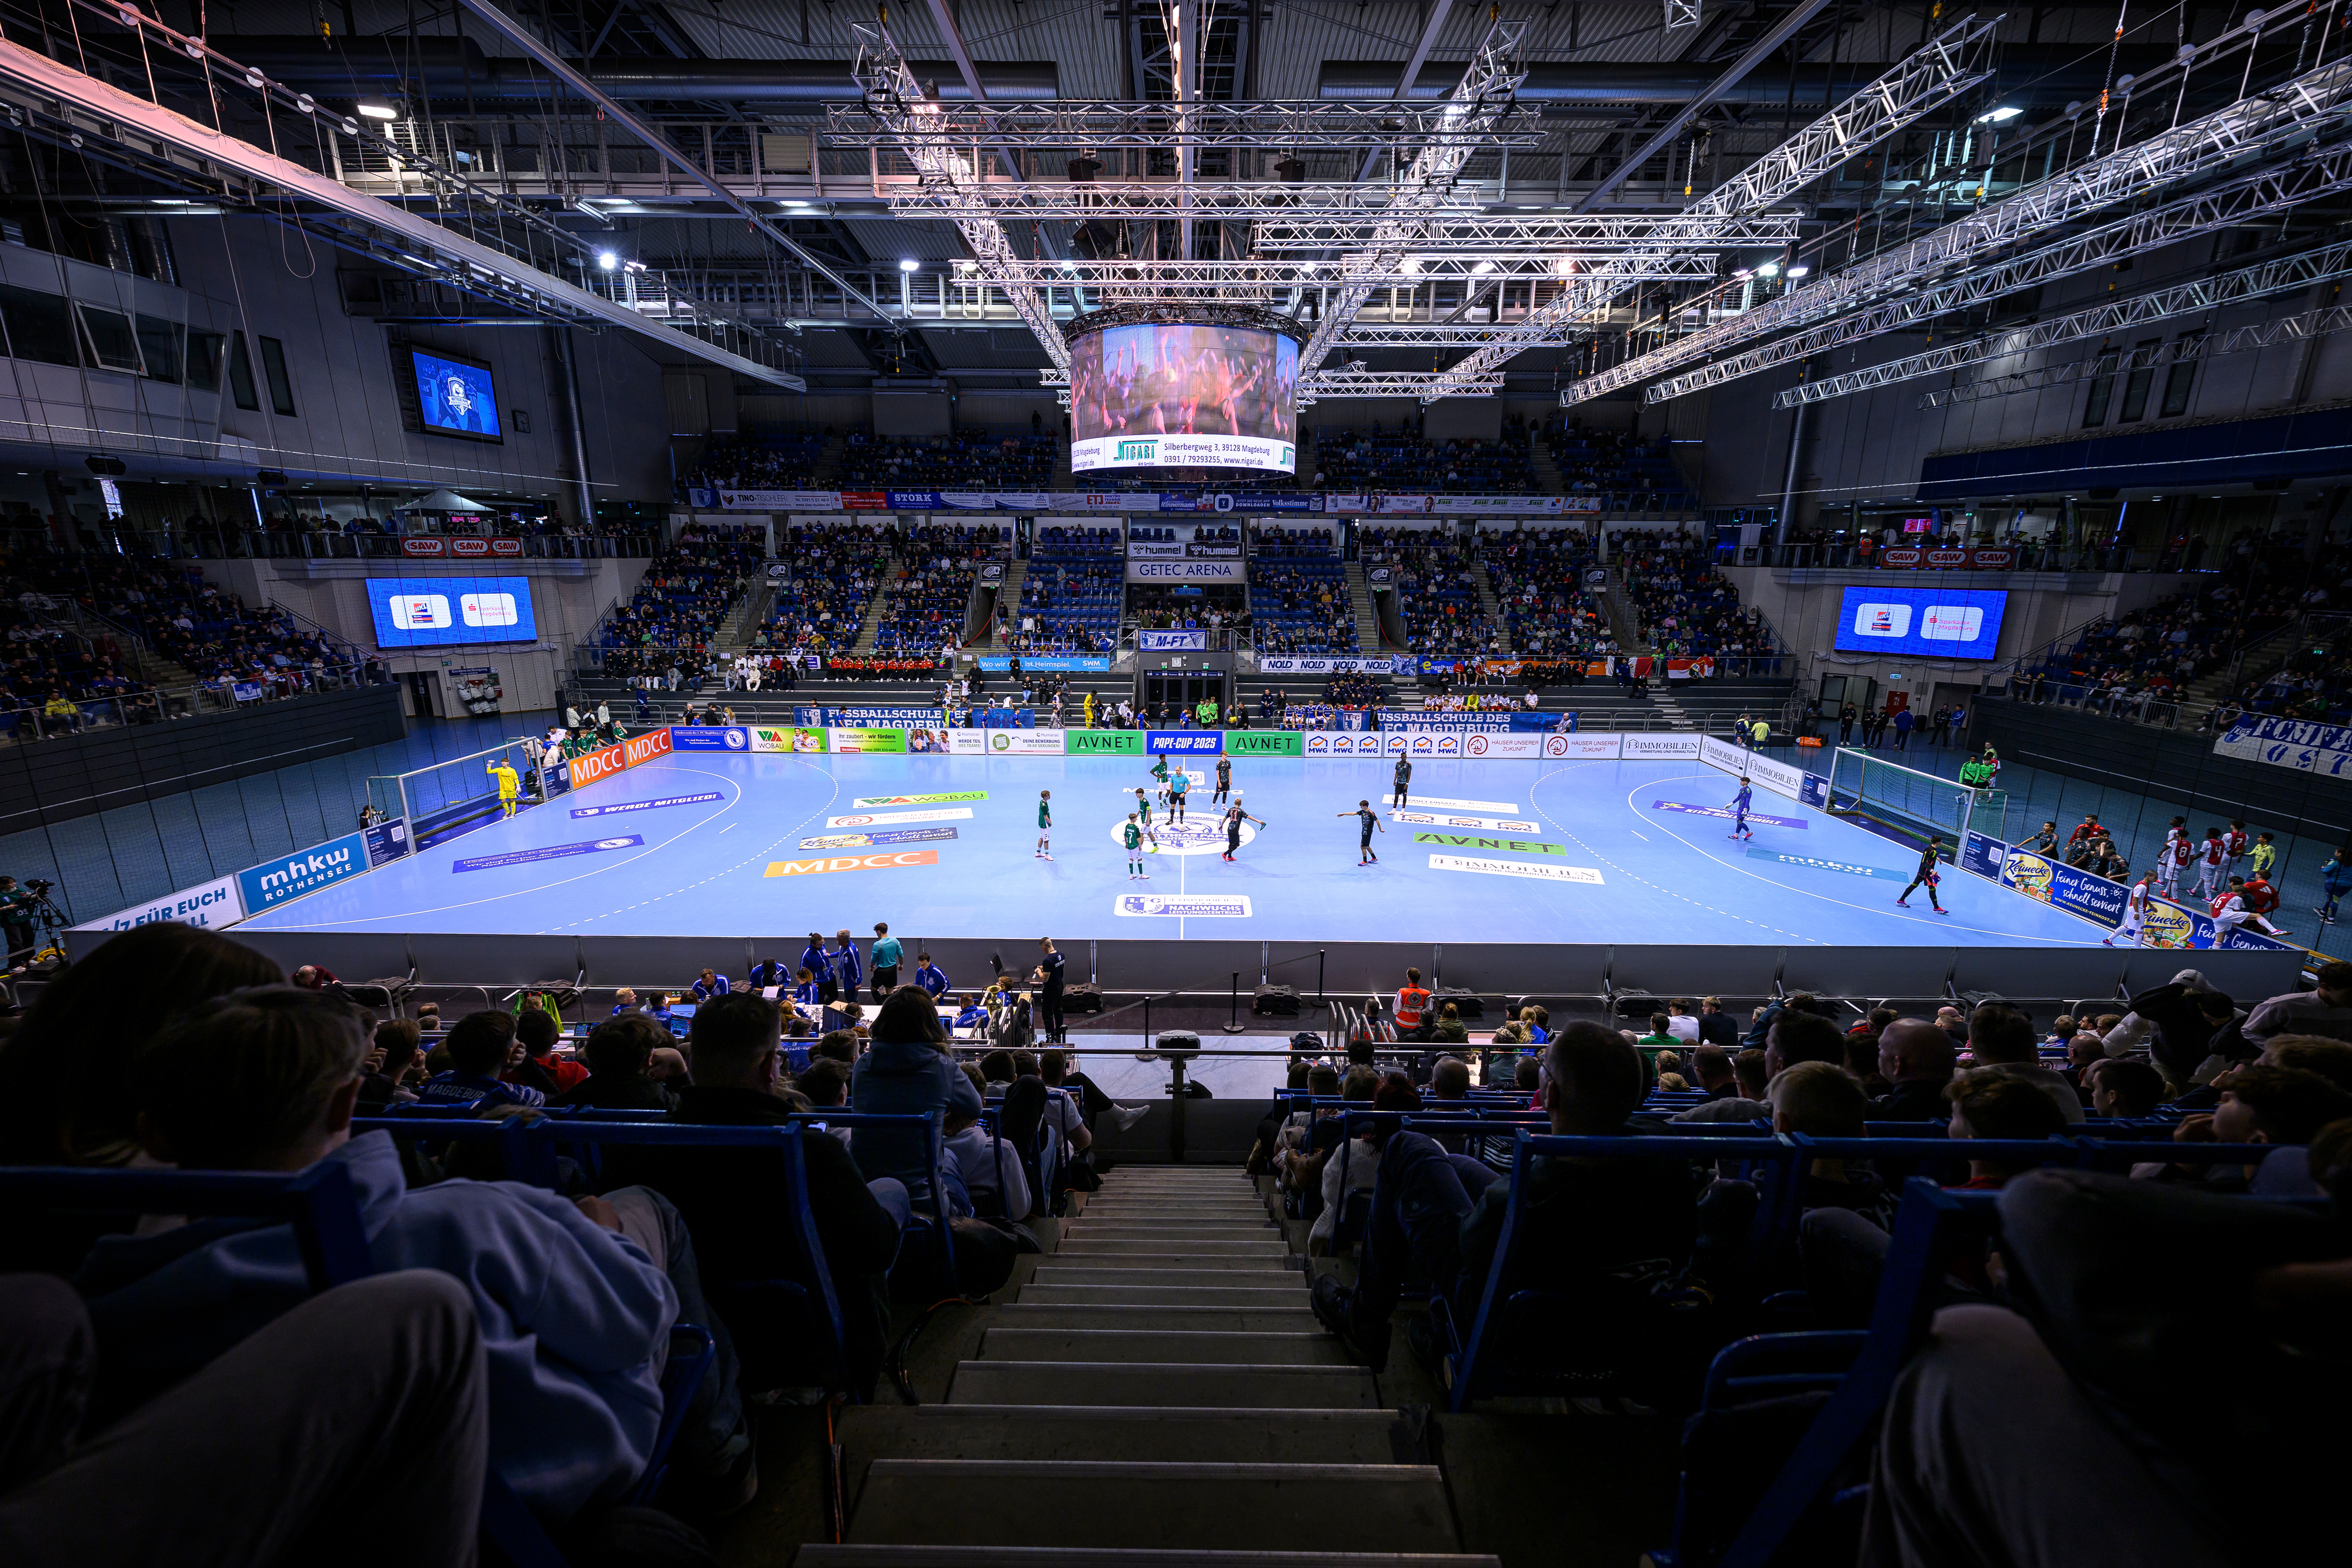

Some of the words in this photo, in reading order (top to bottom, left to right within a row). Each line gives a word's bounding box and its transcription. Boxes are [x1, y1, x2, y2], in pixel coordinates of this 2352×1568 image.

[1080, 447, 1100, 456] Magdeburg
[1115, 440, 1157, 462] NIGARI
[1164, 443, 1212, 453] Silberbergweg
[1222, 444, 1241, 452] 39128
[1242, 446, 1270, 456] Magdeburg
[1182, 456, 1186, 464] /
[1188, 455, 1222, 464] 79293255,
[1224, 457, 1264, 466] www.nigari.de
[1087, 494, 1103, 504] ETJ
[410, 542, 438, 550] SAW
[459, 541, 483, 550] SAW
[497, 541, 517, 550] SAW
[1145, 545, 1181, 554] hummel
[1202, 546, 1239, 555] hummel
[1890, 551, 1918, 561] SAW
[1933, 552, 1963, 561] SAW
[1978, 552, 2007, 561] SAW
[1139, 564, 1181, 576] GETEC
[1185, 564, 1232, 576] ARENA
[415, 603, 427, 612] HKL
[1156, 636, 1188, 647] M-FT
[1035, 661, 1071, 669] Heimspiel.
[1268, 660, 1293, 669] NOLD
[1300, 660, 1326, 669] NOLD
[1332, 661, 1358, 670] NOLD
[1365, 661, 1391, 670] NOLD
[1486, 714, 1511, 722] DES
[1406, 724, 1510, 733] MAGDEBURG
[628, 731, 669, 763] MDCC
[1077, 737, 1134, 748] AVNET
[1153, 737, 1193, 748] PAPE-CUP
[1194, 737, 1217, 748] 2025
[1235, 738, 1293, 749] AVNET
[1710, 746, 1745, 766] IMMOBILIEN
[573, 748, 623, 783] MDCC
[1724, 760, 1738, 769] BEWERTUNG
[1758, 765, 1799, 788] IMMOBILIEN
[913, 793, 983, 802] WOBAU
[604, 802, 650, 813] WERDE
[654, 794, 717, 806] MITGLIED!
[1230, 810, 1238, 822] 11
[1127, 832, 1133, 844] 7
[1418, 834, 1553, 852] AVNET
[2235, 838, 2243, 848] 7
[2179, 847, 2187, 858] 8
[2214, 845, 2222, 857] 4
[1922, 851, 1927, 863] 1
[260, 846, 350, 891] mhkw
[783, 852, 921, 874] MDCC
[1779, 854, 1873, 873] mhkw
[1779, 858, 1872, 875] ROTHENSEE
[1466, 861, 1595, 878] IMMOBILIEN
[265, 862, 352, 901] ROTHENSEE
[2056, 870, 2079, 887] Feiner
[2080, 880, 2109, 898] Genuss,
[2063, 889, 2089, 905] schnell
[2091, 900, 2122, 914] serviert
[2214, 896, 2226, 908] 6
[135, 905, 174, 928] FÜR
[178, 887, 226, 914] EUCH
[2054, 897, 2117, 925] WWW.KEUNECKE-FEINKOST.DE
